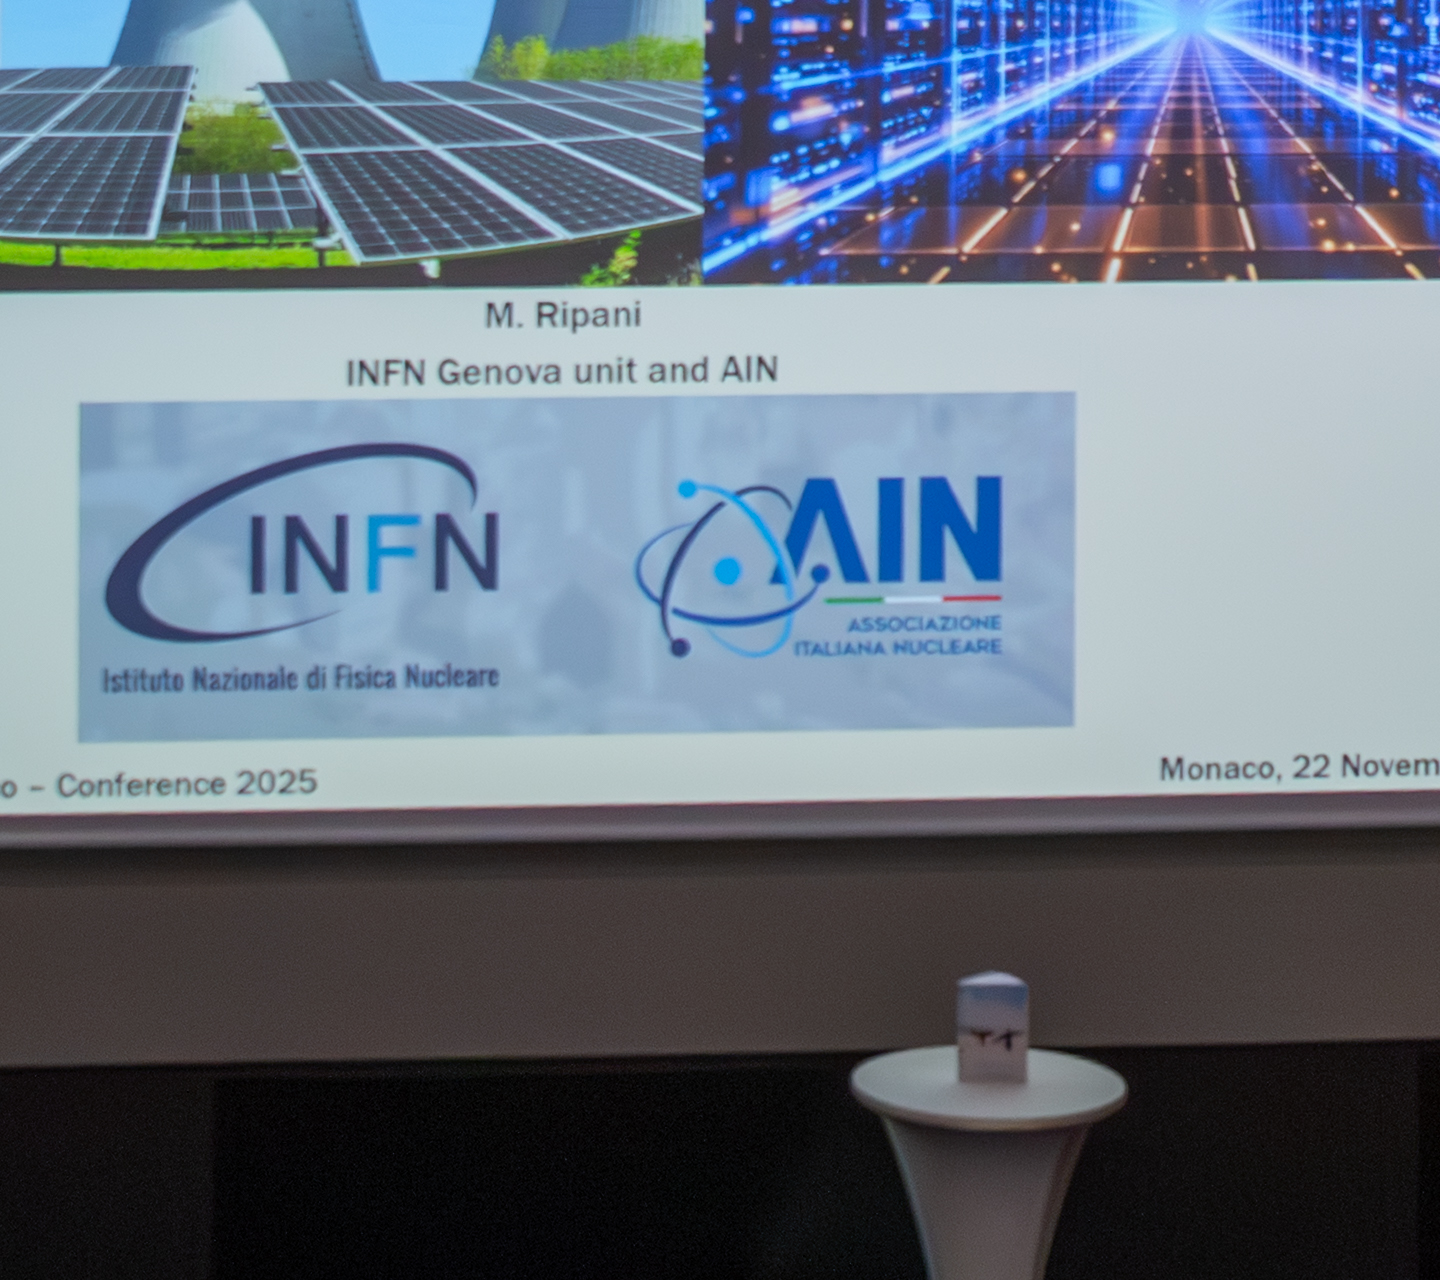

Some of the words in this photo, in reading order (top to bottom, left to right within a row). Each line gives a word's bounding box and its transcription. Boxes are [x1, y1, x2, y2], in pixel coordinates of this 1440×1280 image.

[484, 301, 523, 329] M.
[536, 299, 642, 335] Ripani
[346, 358, 426, 387] INFN
[437, 358, 562, 387] Genova
[574, 357, 637, 385] unit
[647, 356, 710, 384] and
[720, 355, 779, 383] AIN
[770, 475, 1003, 585] AIN
[250, 511, 500, 595] INFN
[846, 614, 1003, 633] ASSOCIAZIONE
[793, 639, 888, 657] ITALIANA
[892, 637, 1003, 656] NUCLEARE
[101, 667, 185, 695] Istituto
[191, 664, 299, 693] Nazionale
[305, 663, 328, 692] di
[334, 662, 397, 691] Fisica
[403, 661, 501, 690] Nucleare
[54, 771, 228, 800] Conference
[235, 768, 319, 797] 2025
[1159, 756, 1283, 784] Monaco,
[1291, 753, 1332, 780] 22
